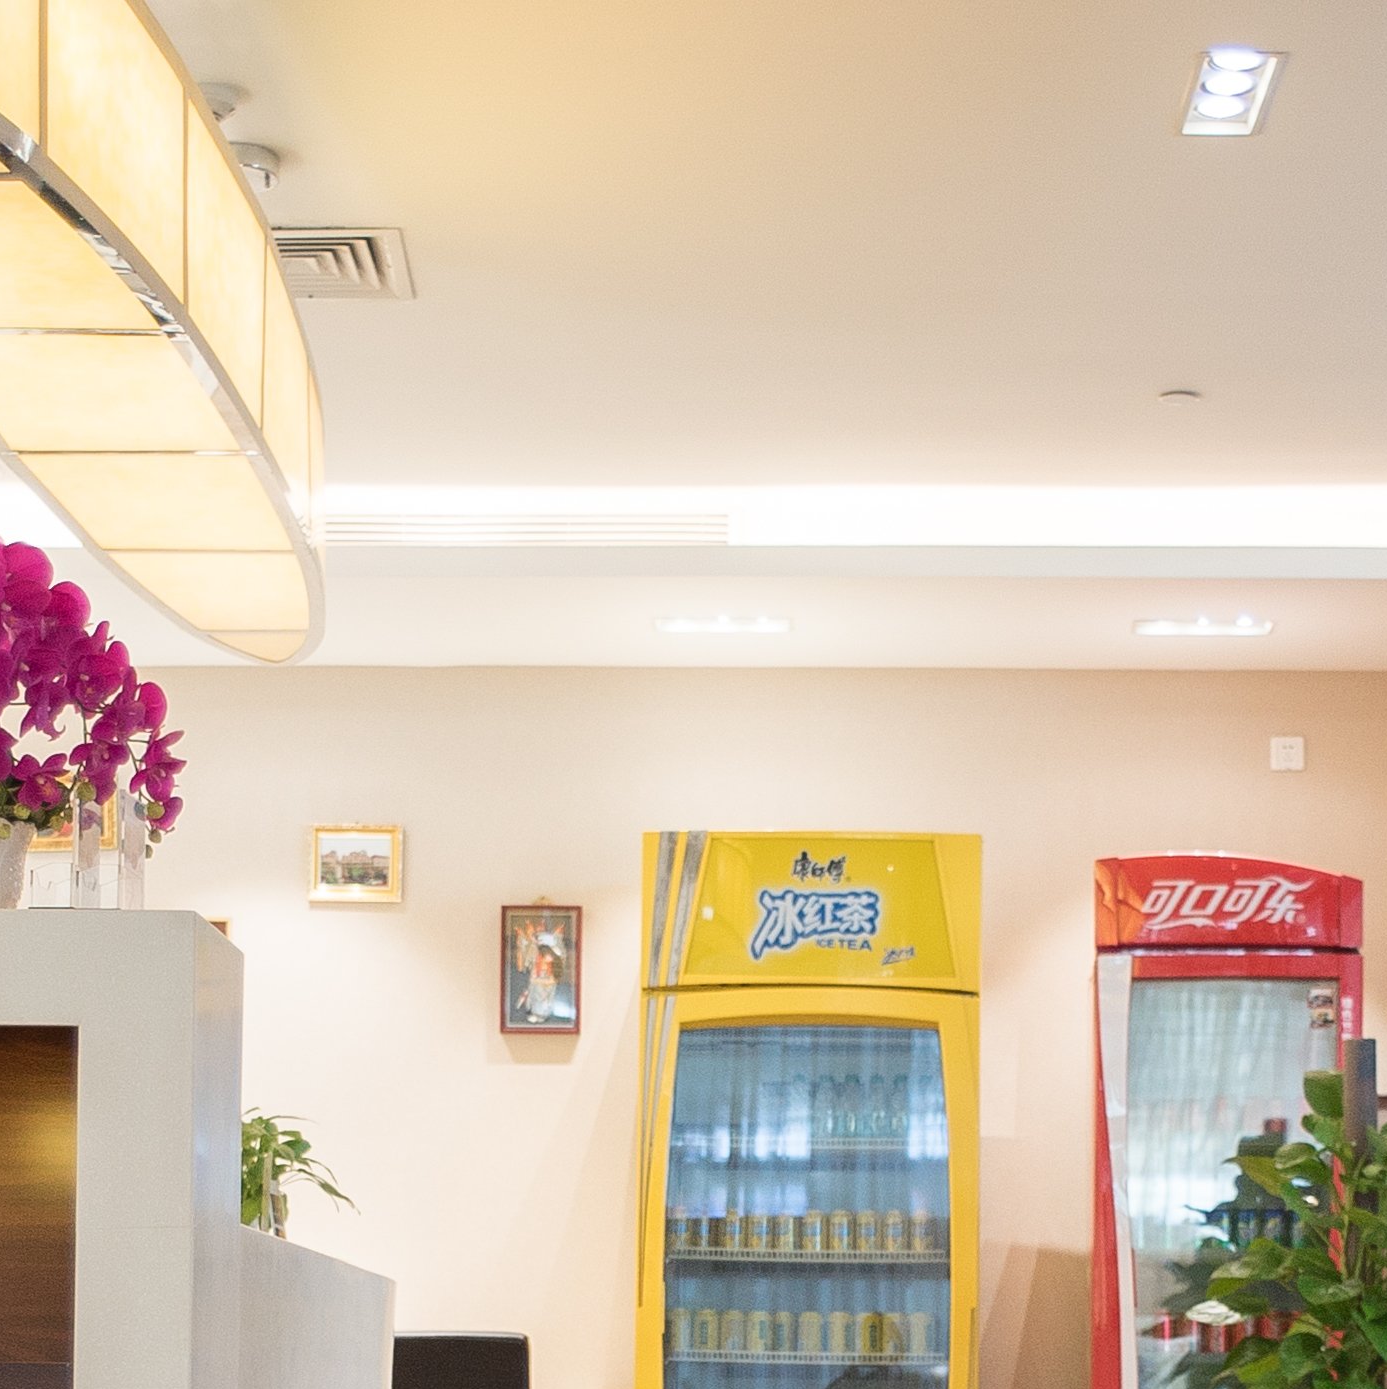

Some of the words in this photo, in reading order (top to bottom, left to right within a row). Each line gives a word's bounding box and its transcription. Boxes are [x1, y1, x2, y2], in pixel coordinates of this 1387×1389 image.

[791, 851, 847, 883] 康师傅
[1141, 875, 1315, 930] 可口可乐
[751, 889, 880, 960] 冰红茶
[838, 938, 872, 951] TEA
